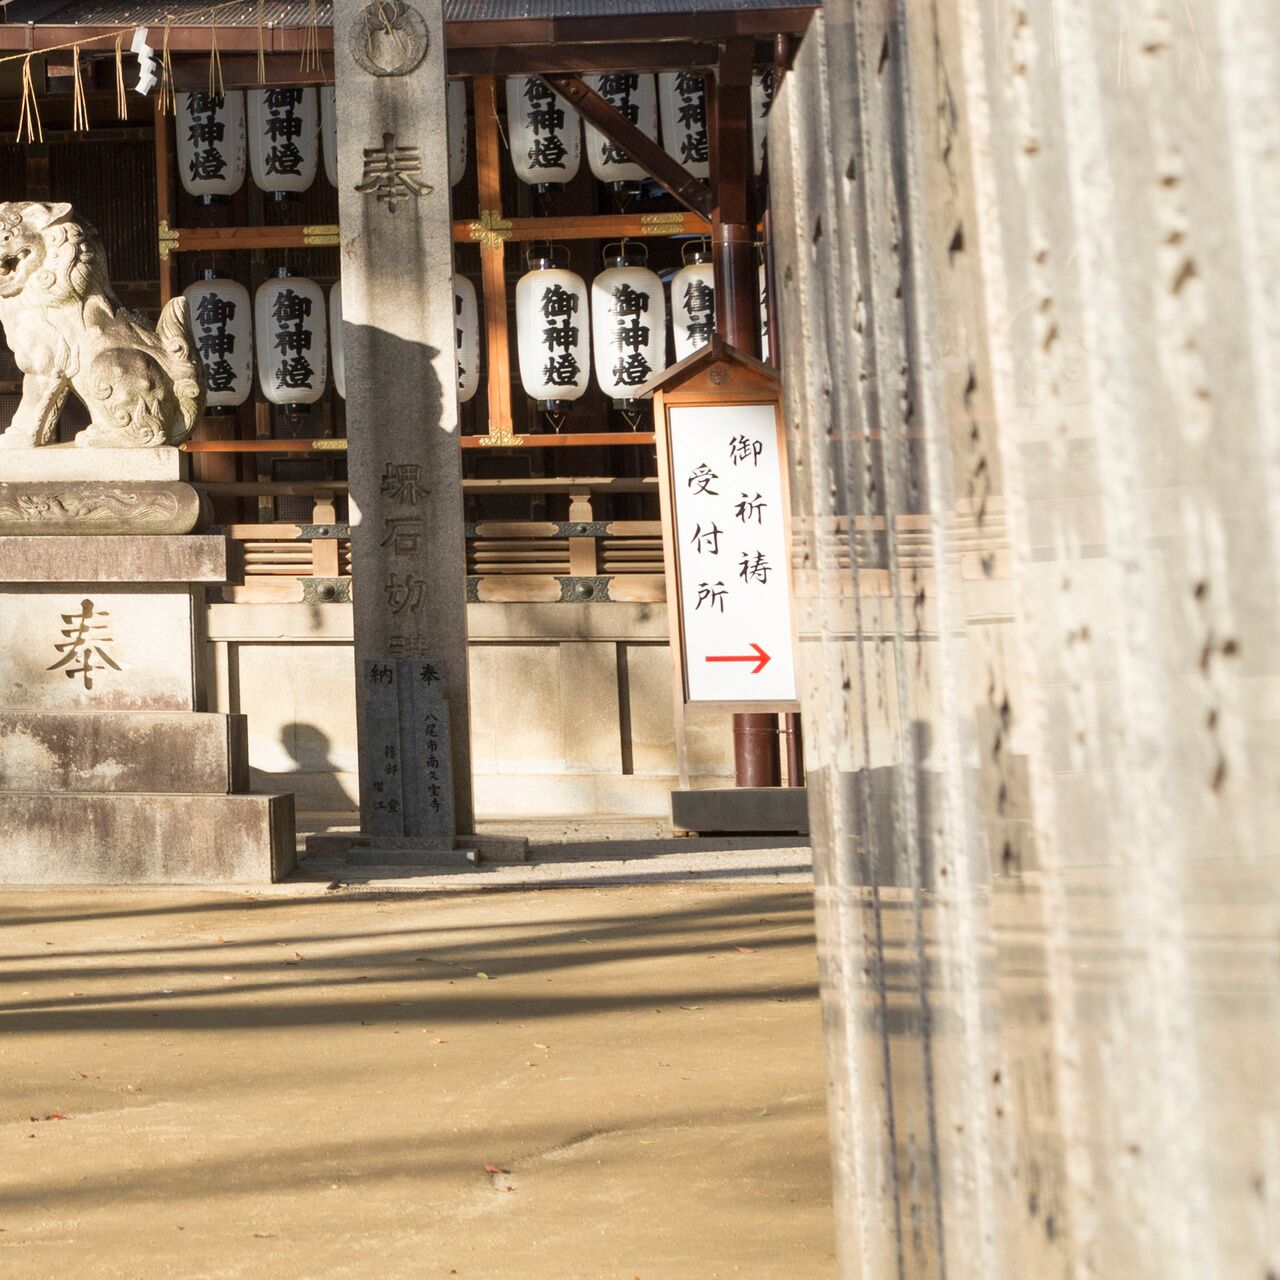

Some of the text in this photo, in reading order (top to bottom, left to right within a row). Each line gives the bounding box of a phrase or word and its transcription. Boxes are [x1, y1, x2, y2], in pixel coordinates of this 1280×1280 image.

[354, 132, 434, 214] 奉
[195, 292, 238, 393] 御神燈
[272, 289, 315, 390] 御神燈
[540, 284, 581, 387] 御神燈
[608, 283, 653, 386] 御神燈
[687, 462, 729, 613] 受付所
[728, 434, 773, 585] 御祈祷
[46, 598, 123, 691] 奉
[370, 664, 393, 684] 納
[420, 664, 439, 685] 奉
